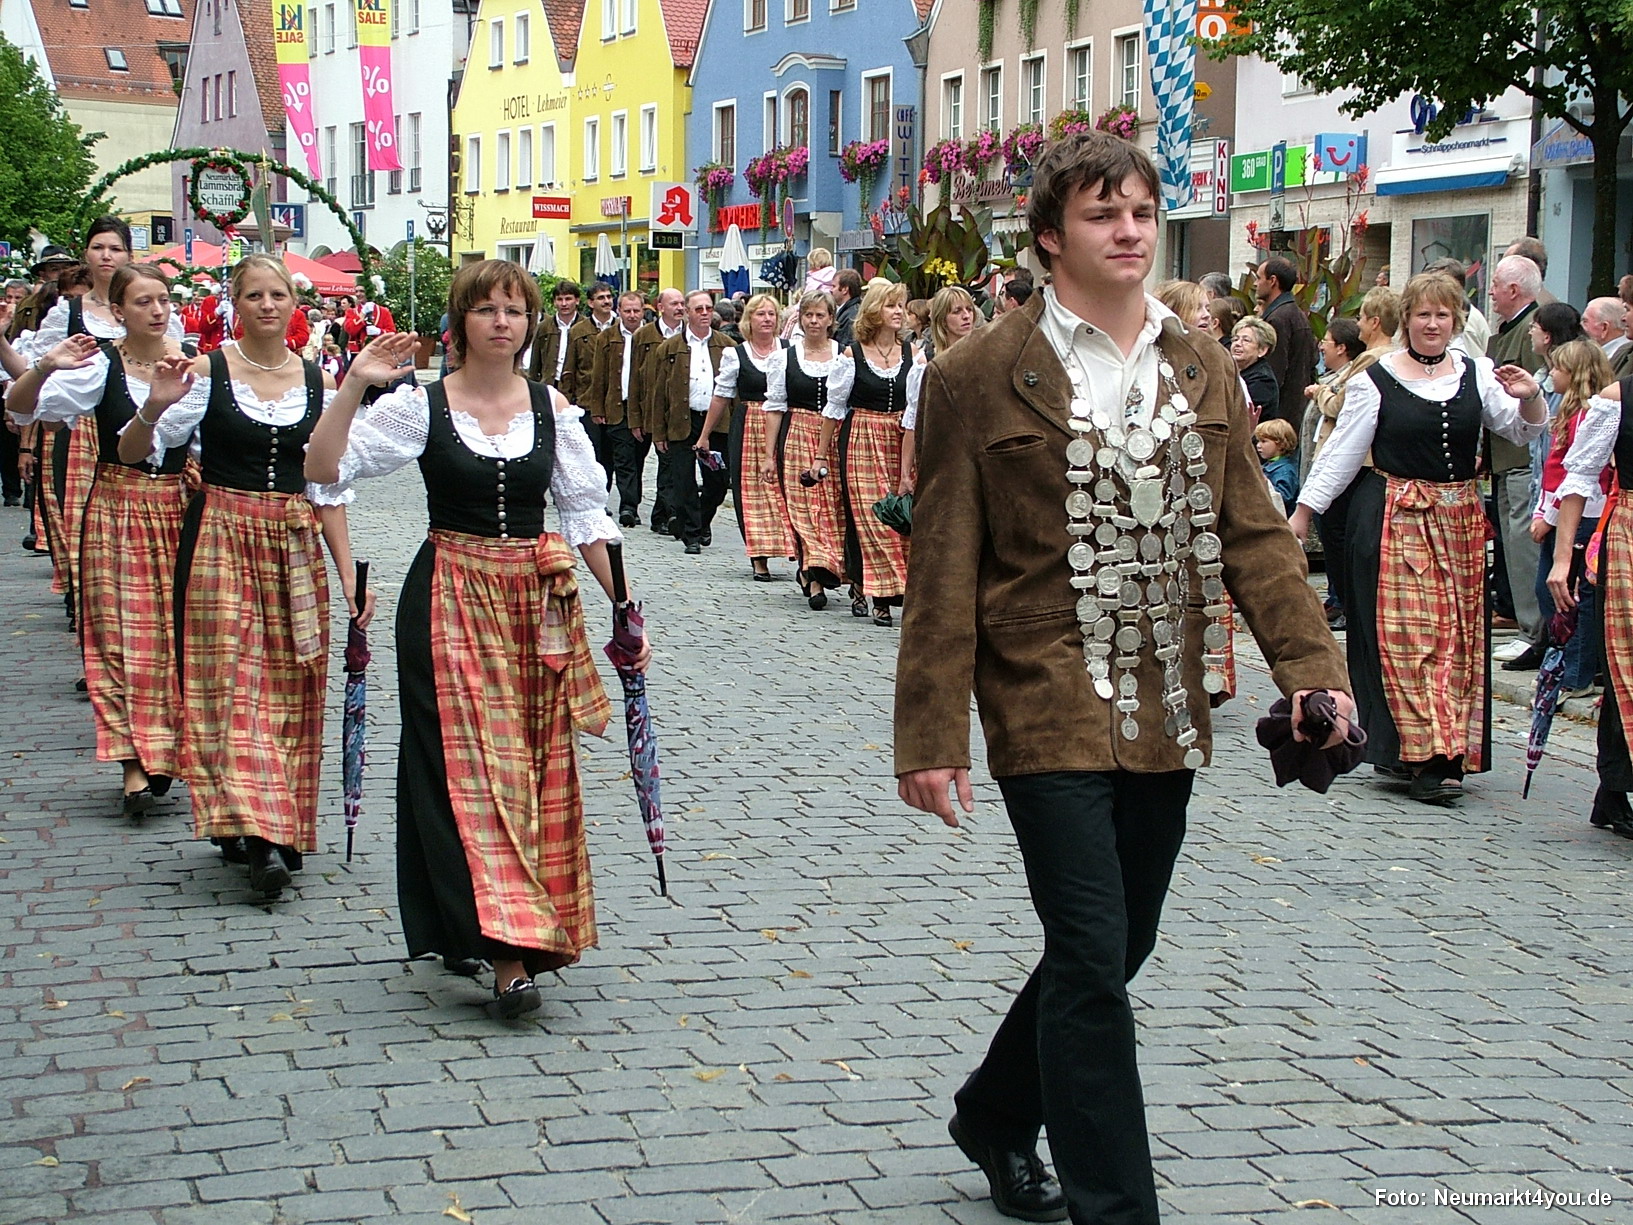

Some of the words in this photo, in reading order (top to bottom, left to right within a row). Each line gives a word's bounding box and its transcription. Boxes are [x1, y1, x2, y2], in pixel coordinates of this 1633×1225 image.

[358, 12, 386, 24] SALE
[503, 95, 530, 120] HOTEL
[536, 91, 568, 113] Lehmeier
[1421, 138, 1490, 154] Schnäppchenmarkt
[1216, 142, 1227, 212] KINO
[1241, 158, 1256, 179] 360
[1274, 150, 1283, 188] P
[533, 203, 570, 213] WISSMACH
[500, 217, 538, 234] Restaurant
[185, 231, 191, 250] P
[331, 285, 356, 293] Lehmei
